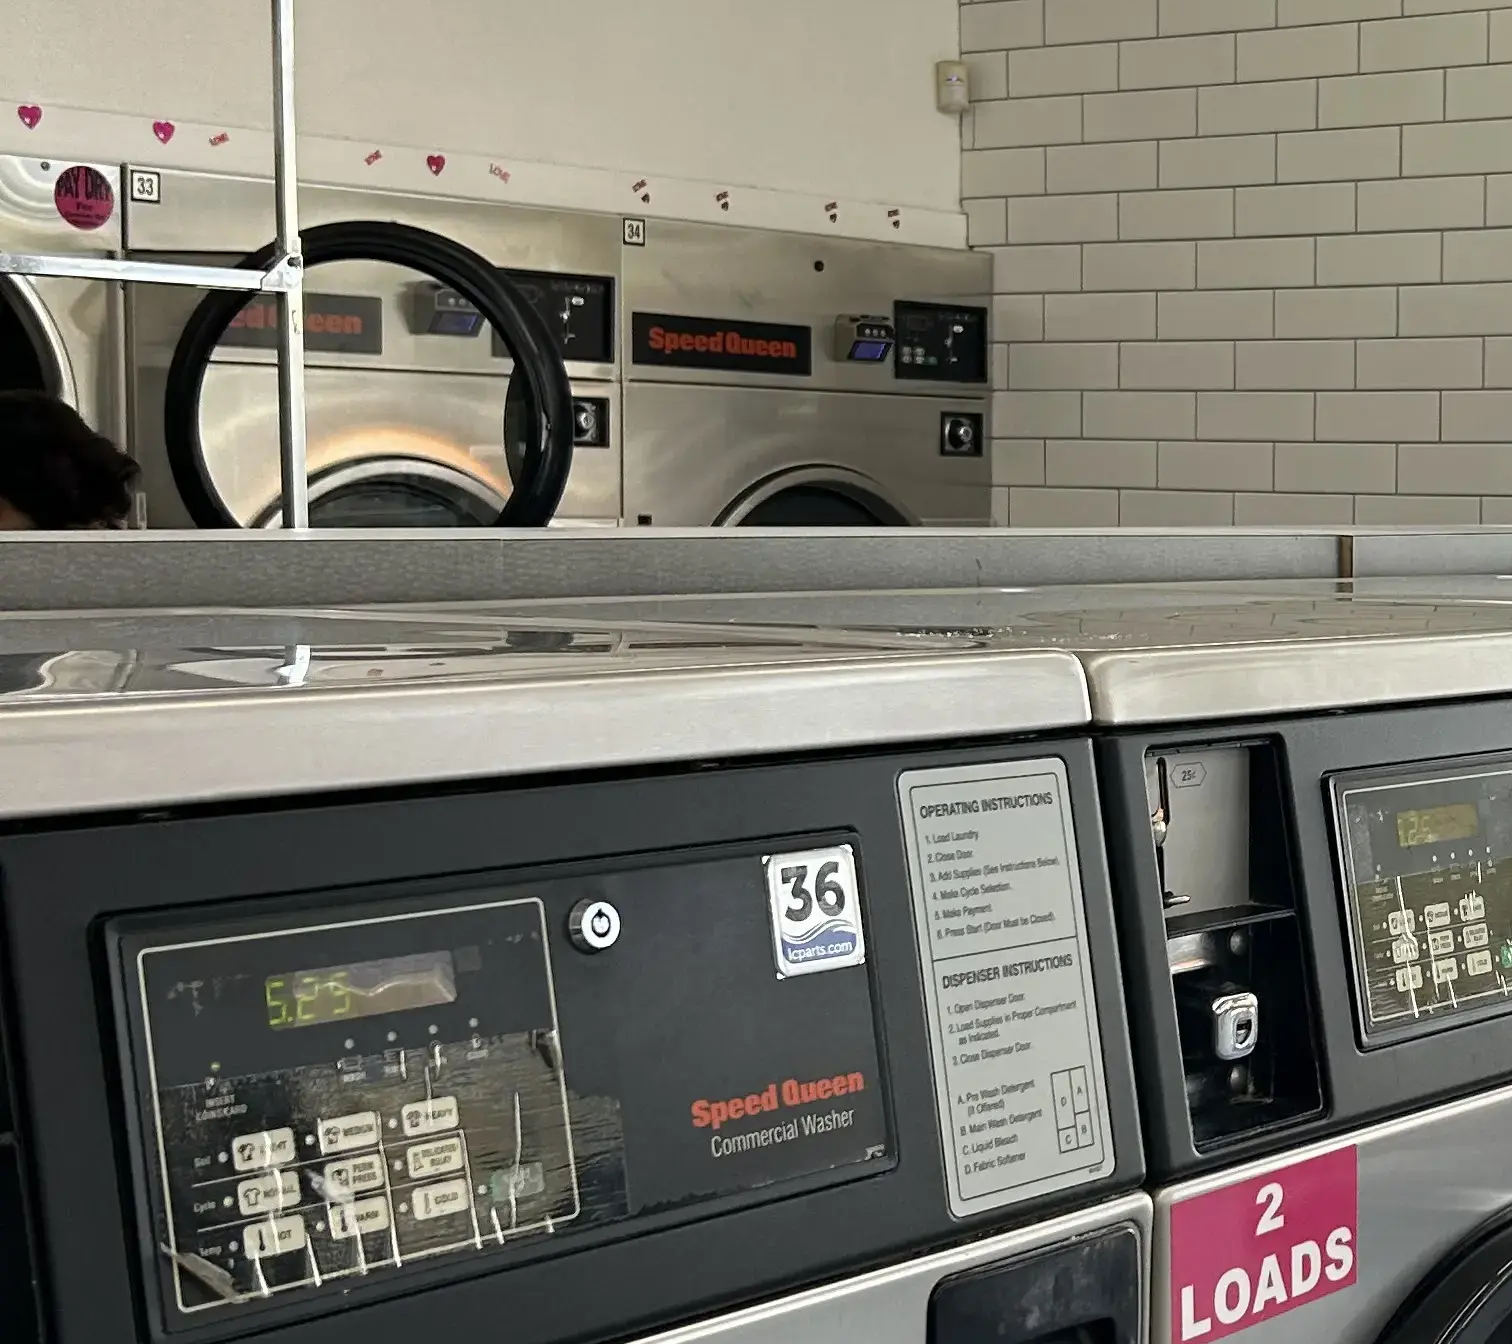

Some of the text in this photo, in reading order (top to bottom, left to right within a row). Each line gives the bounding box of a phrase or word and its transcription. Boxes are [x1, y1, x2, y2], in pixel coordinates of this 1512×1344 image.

[137, 176, 154, 196] 33
[627, 223, 641, 240] 34
[649, 326, 797, 358] Speed Queen
[920, 792, 1053, 819] OPERATING INSTRUCTIONS
[781, 861, 846, 922] 36
[942, 955, 1073, 989] DISPENSER INSTRUCTIONS
[691, 1071, 865, 1130] Speed Queen
[711, 1108, 855, 1158] Commercial Washer
[973, 1160, 996, 1172] Fabric
[1255, 1182, 1285, 1236] 2
[1181, 1226, 1354, 1342] LOADS
